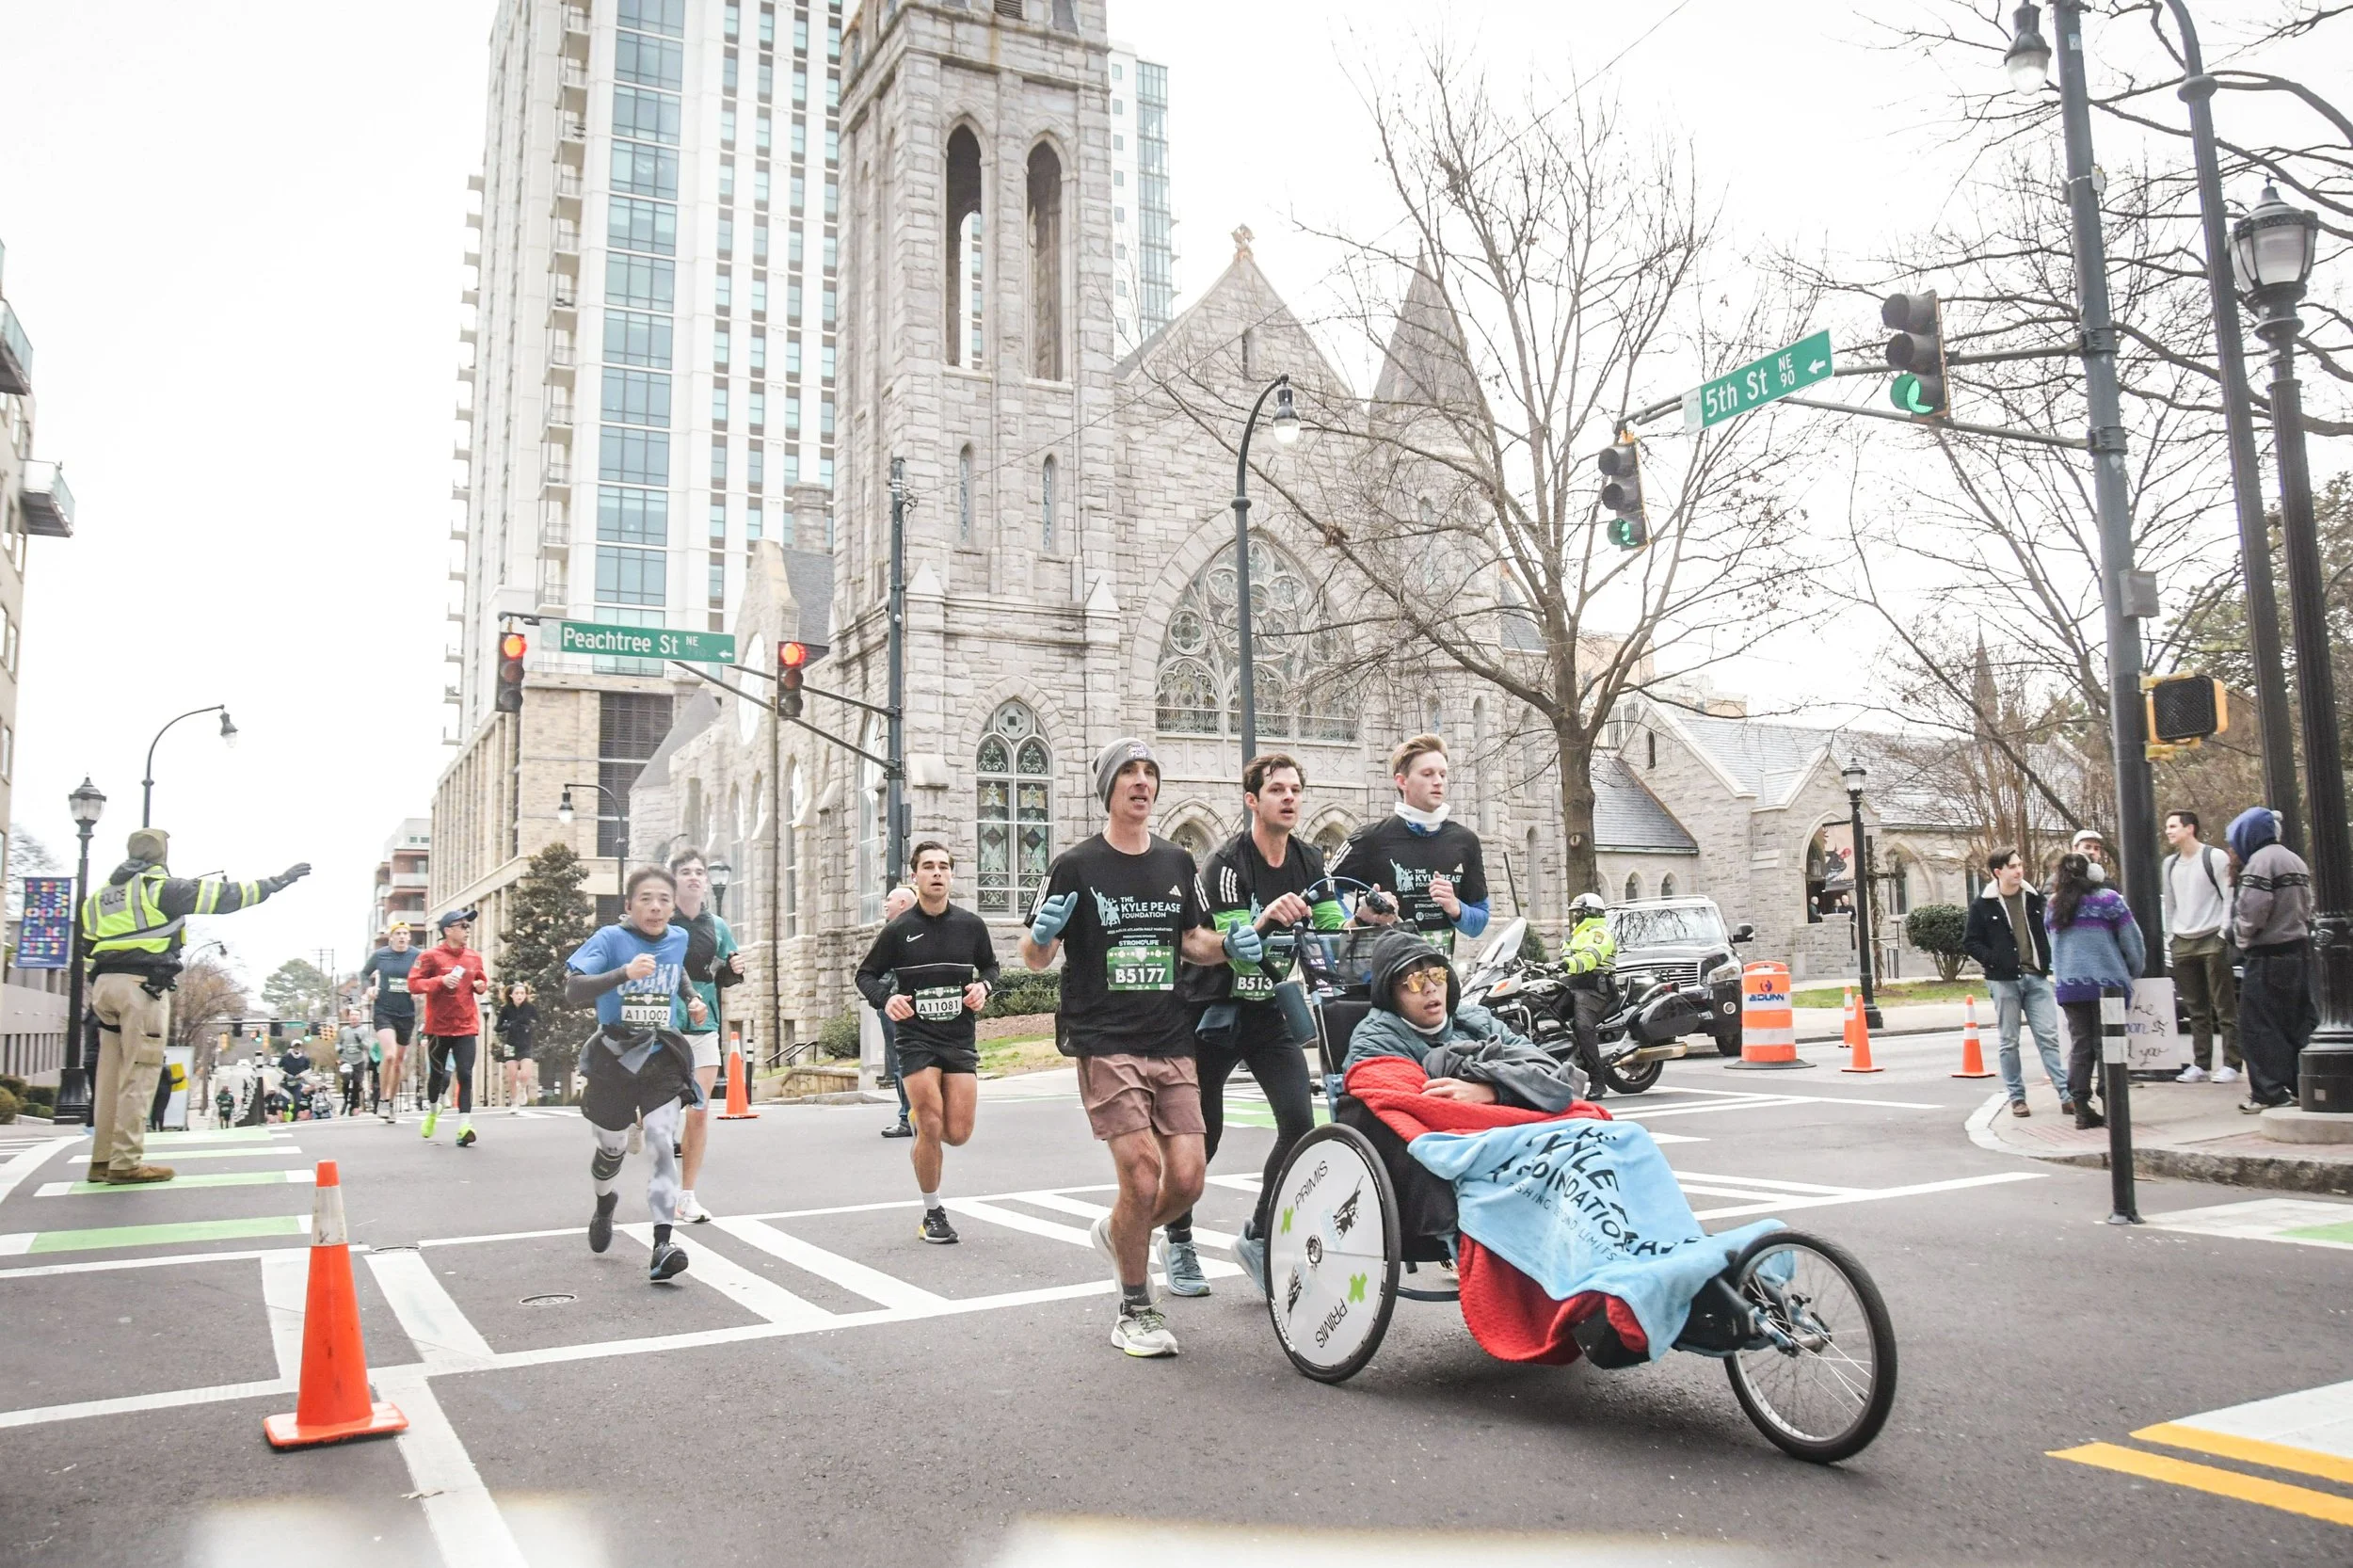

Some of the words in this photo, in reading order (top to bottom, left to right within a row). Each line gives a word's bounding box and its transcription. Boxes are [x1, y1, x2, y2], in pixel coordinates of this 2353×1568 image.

[1705, 382, 1738, 419] 5th
[1746, 367, 1769, 401] St
[1778, 353, 1794, 373] NE
[1780, 369, 1796, 388] 90
[563, 627, 652, 653] Peachtree
[659, 633, 679, 656] St
[685, 635, 699, 647] NE
[100, 888, 126, 905] POLICE
[1121, 903, 1148, 913] KYLE
[1150, 902, 1181, 913] PEASE
[1114, 968, 1166, 984] B5177
[1237, 976, 1273, 991] B513
[624, 1009, 668, 1021] A11002
[919, 1000, 958, 1013] A11081
[1294, 1160, 1329, 1211] PRIMIS
[1506, 1159, 1630, 1252] ONDATIO
[1508, 1181, 1552, 1209] SHING
[1577, 1227, 1618, 1262] LIMITS
[1315, 1298, 1349, 1350] PRIMIS
